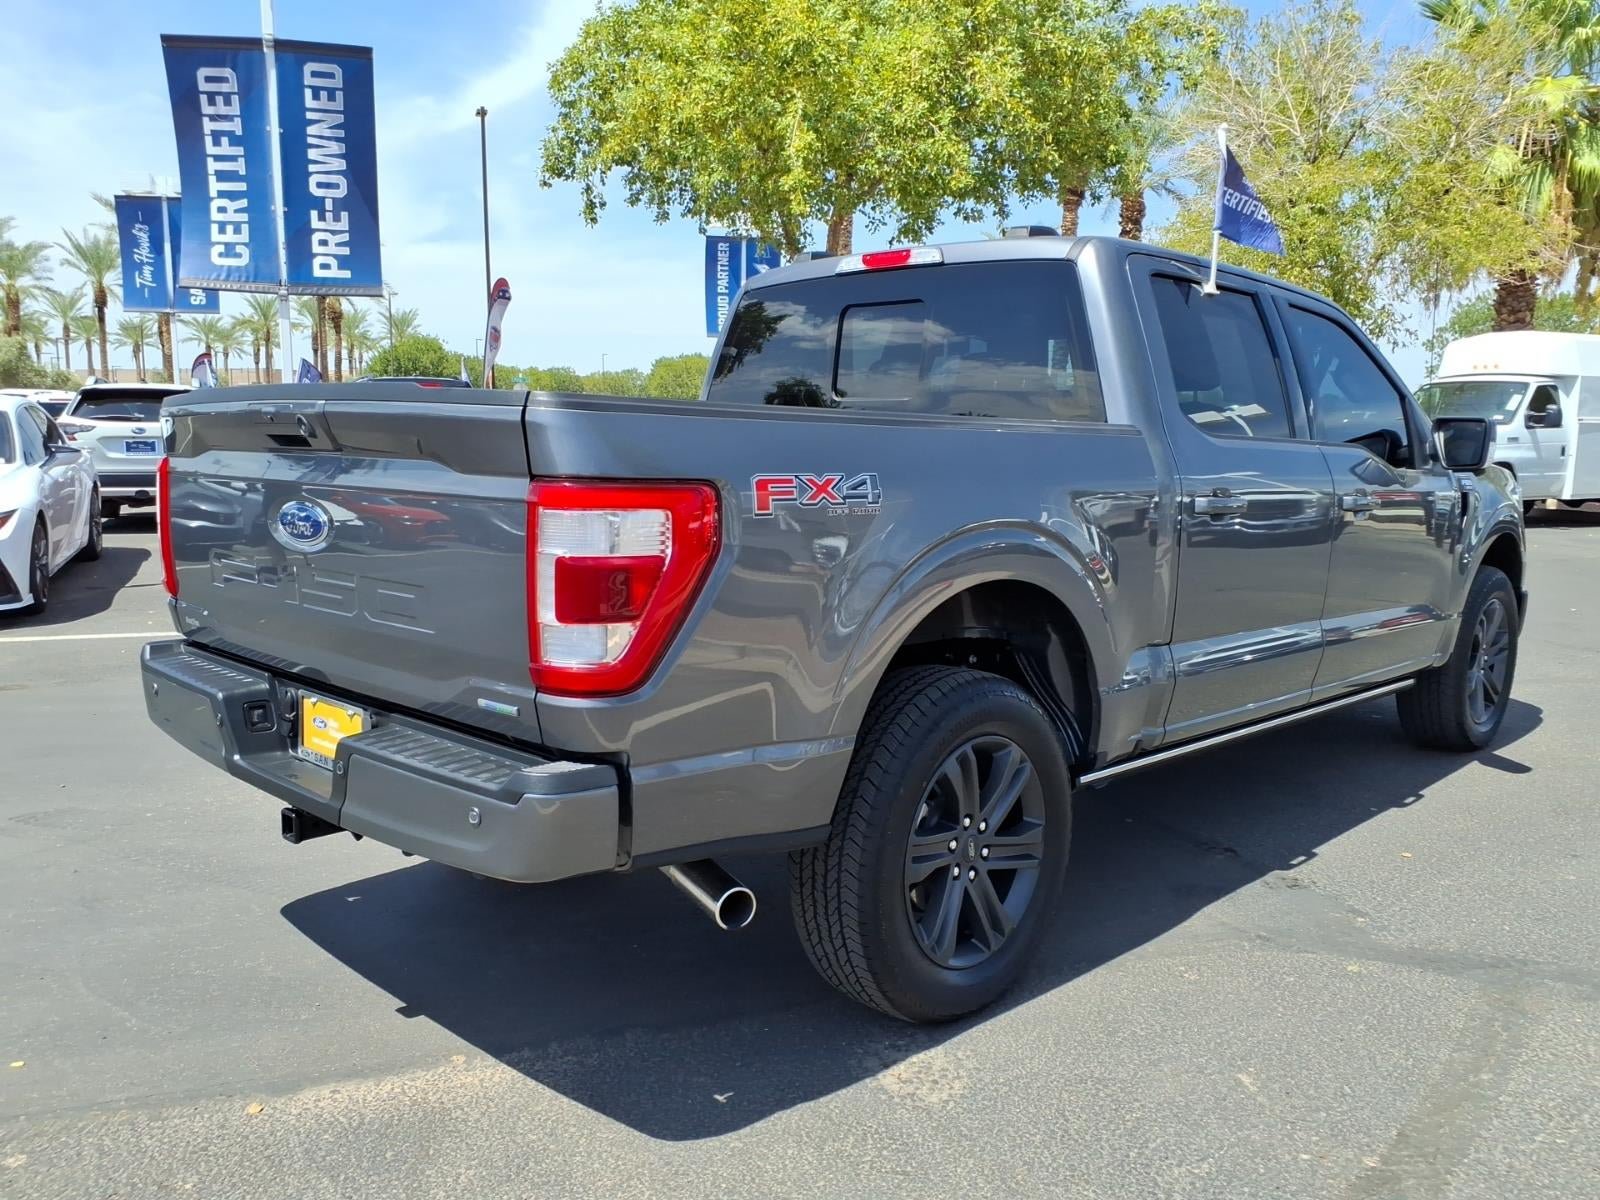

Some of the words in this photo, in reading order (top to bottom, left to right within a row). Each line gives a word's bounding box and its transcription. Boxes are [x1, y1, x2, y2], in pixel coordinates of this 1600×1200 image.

[196, 67, 250, 266] CERTIFIED
[303, 62, 352, 278] PRE-OWNED
[1222, 187, 1271, 224] ERTIFIED
[135, 264, 157, 288] Tim
[717, 242, 729, 293] PARTNER
[751, 473, 882, 518] FX4
